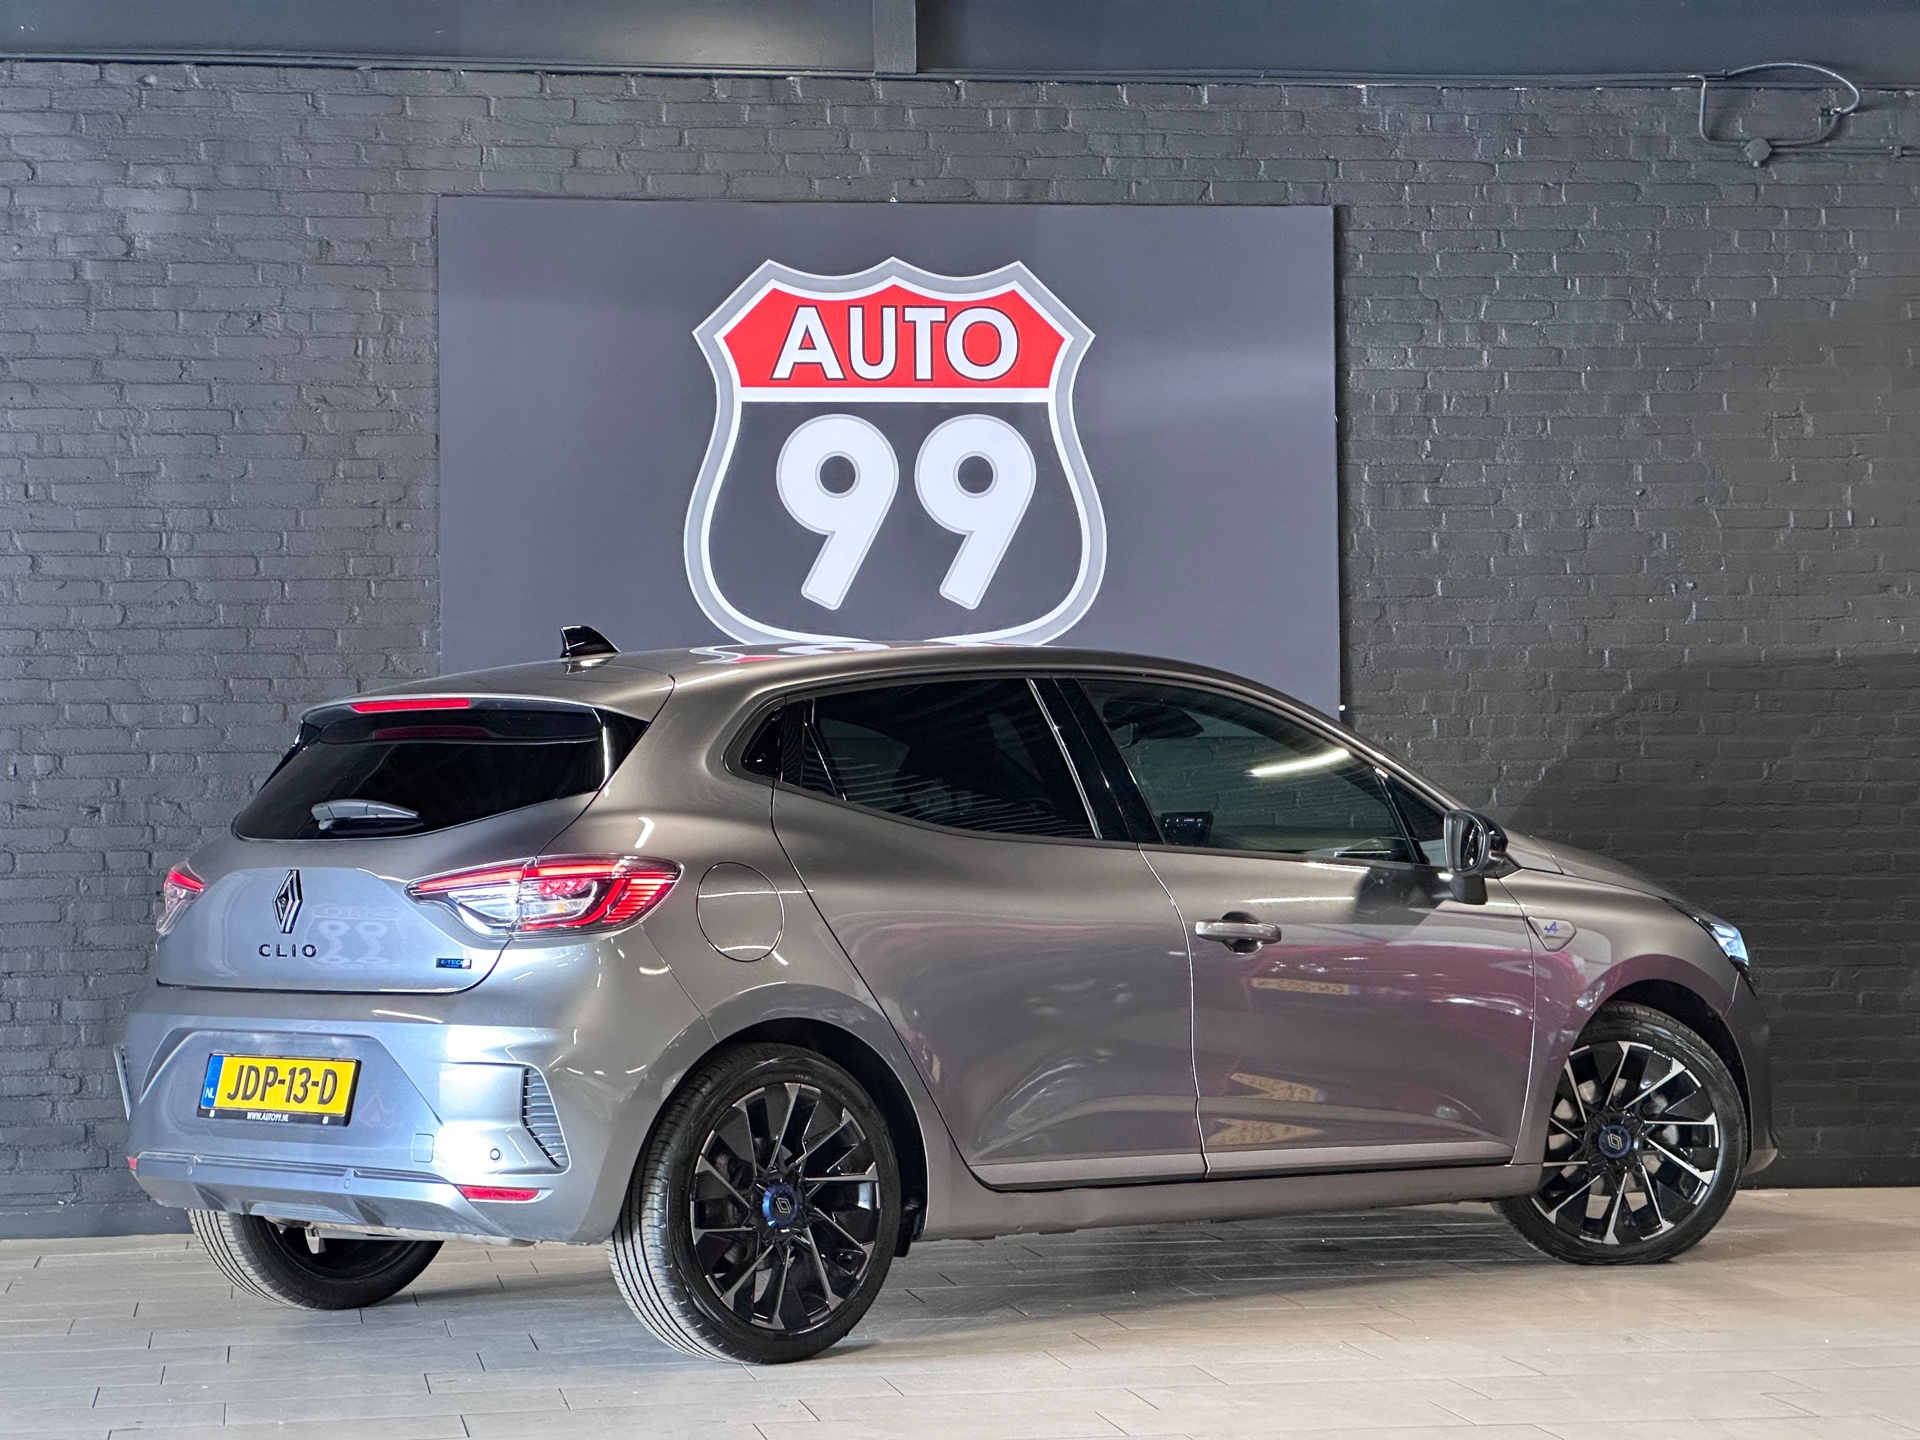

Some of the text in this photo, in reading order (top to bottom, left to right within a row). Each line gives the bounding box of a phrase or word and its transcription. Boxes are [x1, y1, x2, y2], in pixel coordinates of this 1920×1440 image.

[769, 304, 1020, 382] AUTO
[776, 413, 1037, 611] 99
[258, 943, 317, 958] CLIO
[204, 1087, 215, 1099] NL
[226, 1064, 338, 1106] JDP-13-D
[246, 1111, 289, 1123] WWW.AUTO99.NL
